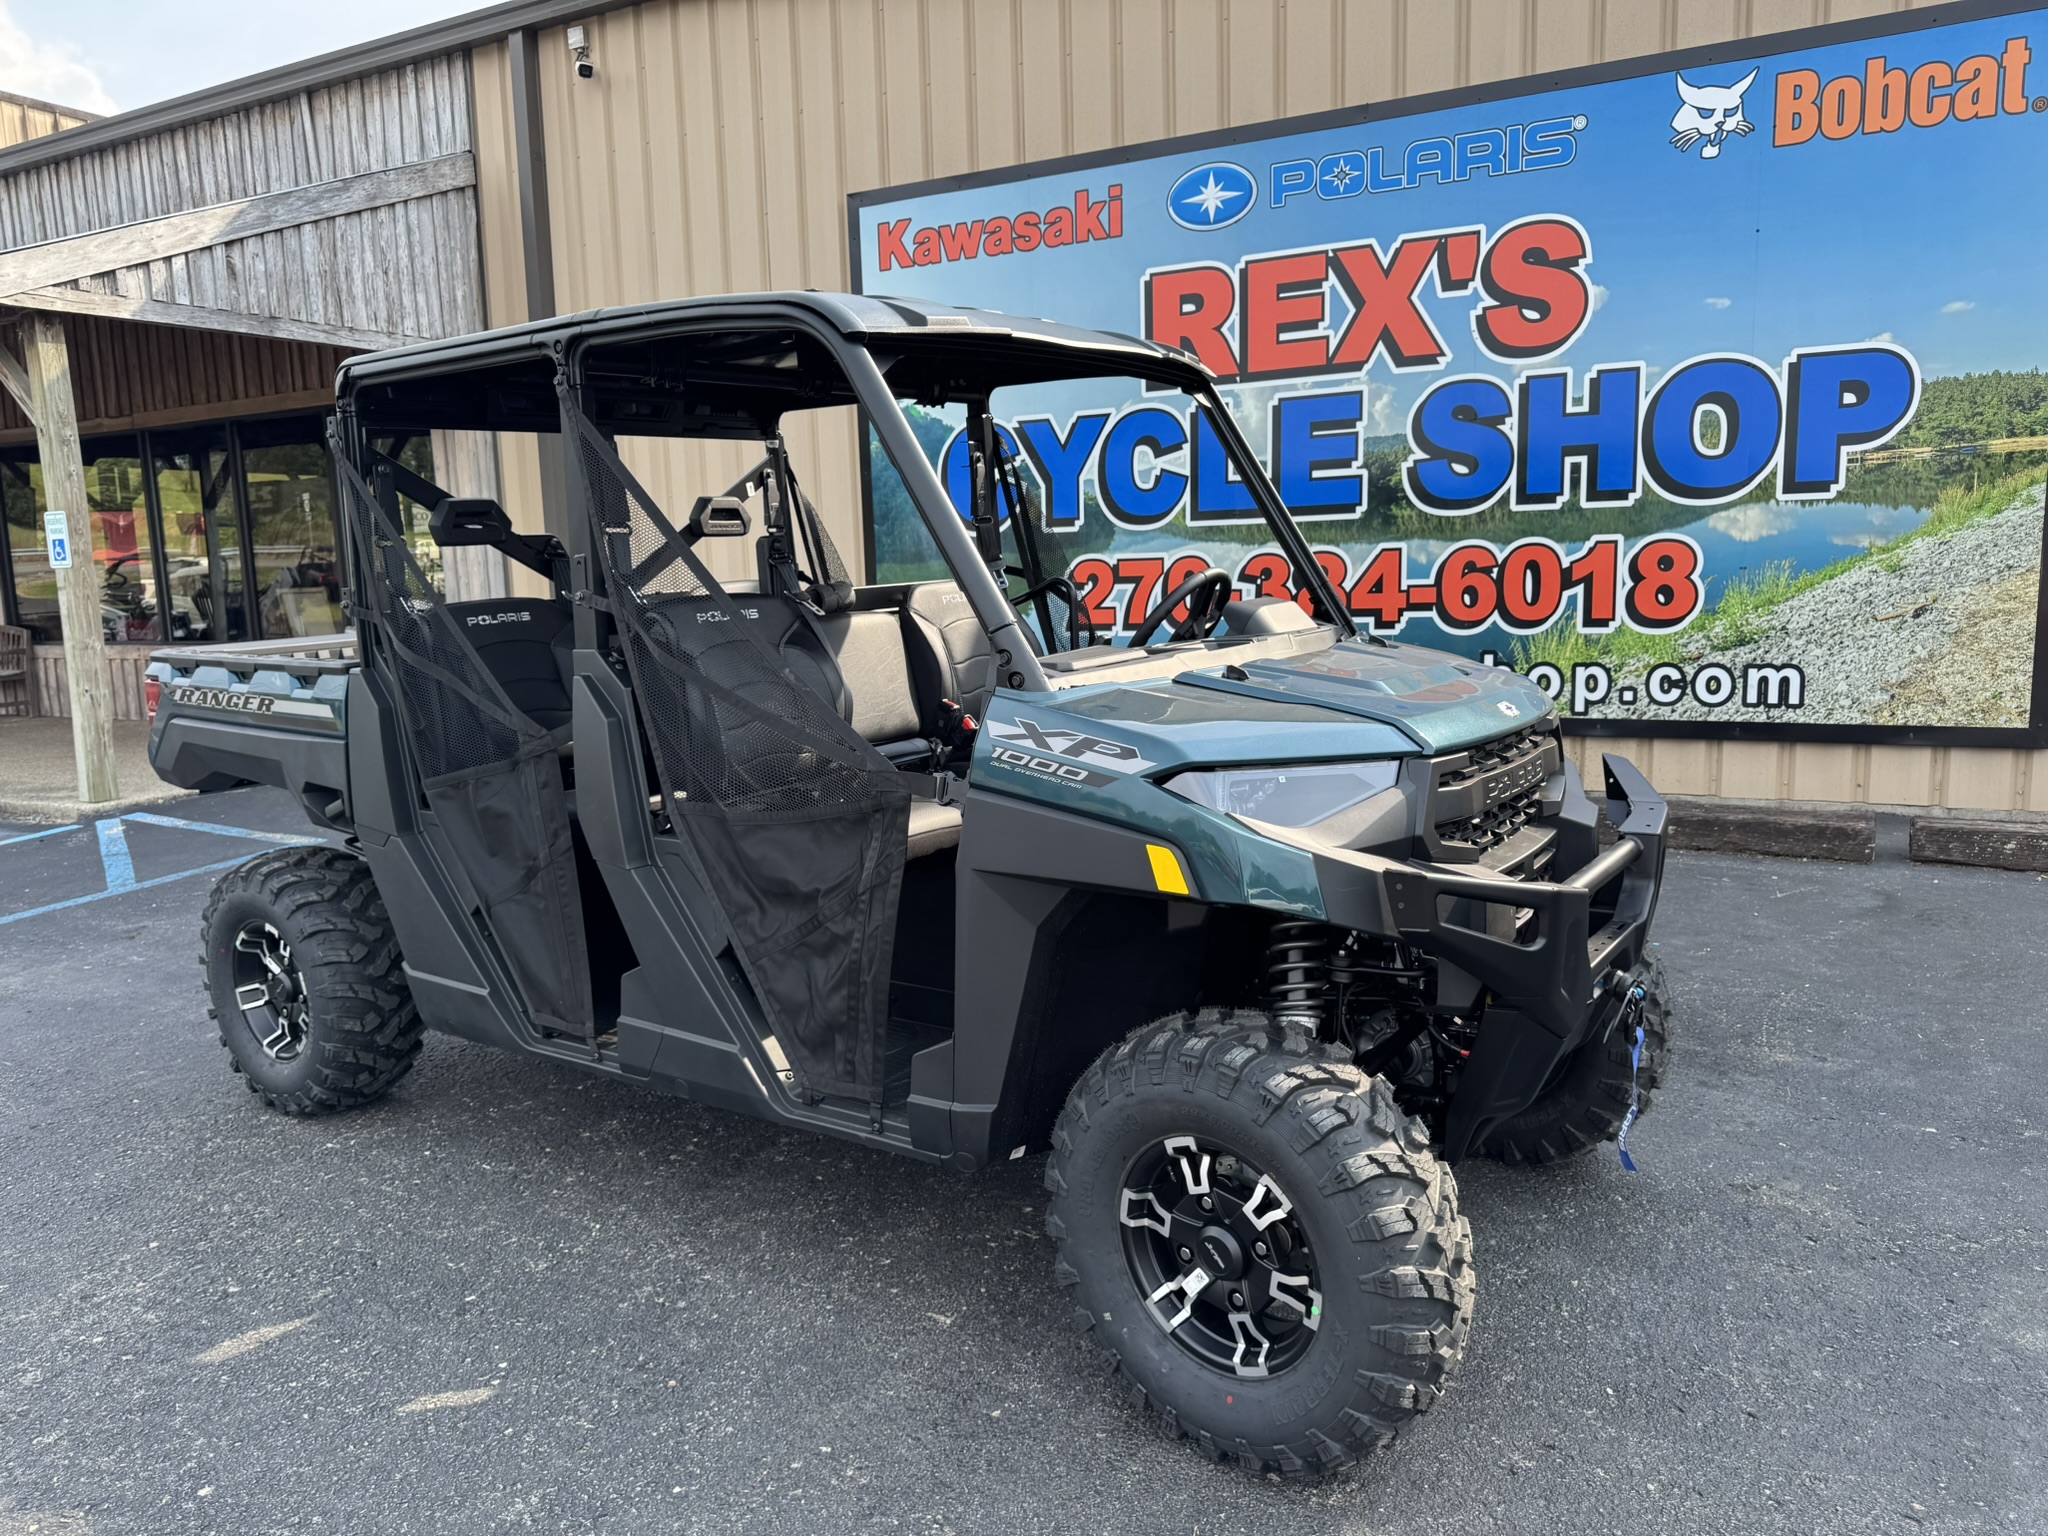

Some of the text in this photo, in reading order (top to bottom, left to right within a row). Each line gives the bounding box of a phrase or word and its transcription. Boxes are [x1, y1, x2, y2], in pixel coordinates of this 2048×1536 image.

[877, 183, 1124, 272] Kawasaki
[1144, 218, 1589, 390] REX'S
[1403, 348, 1914, 508] SHOP
[466, 611, 531, 627] POLARIS
[696, 608, 759, 624] POLIS
[177, 687, 276, 714] RANGER
[990, 716, 1141, 761] XP
[989, 760, 1083, 790] DUAL OVERHEAD CAM
[990, 746, 1089, 781] 1000
